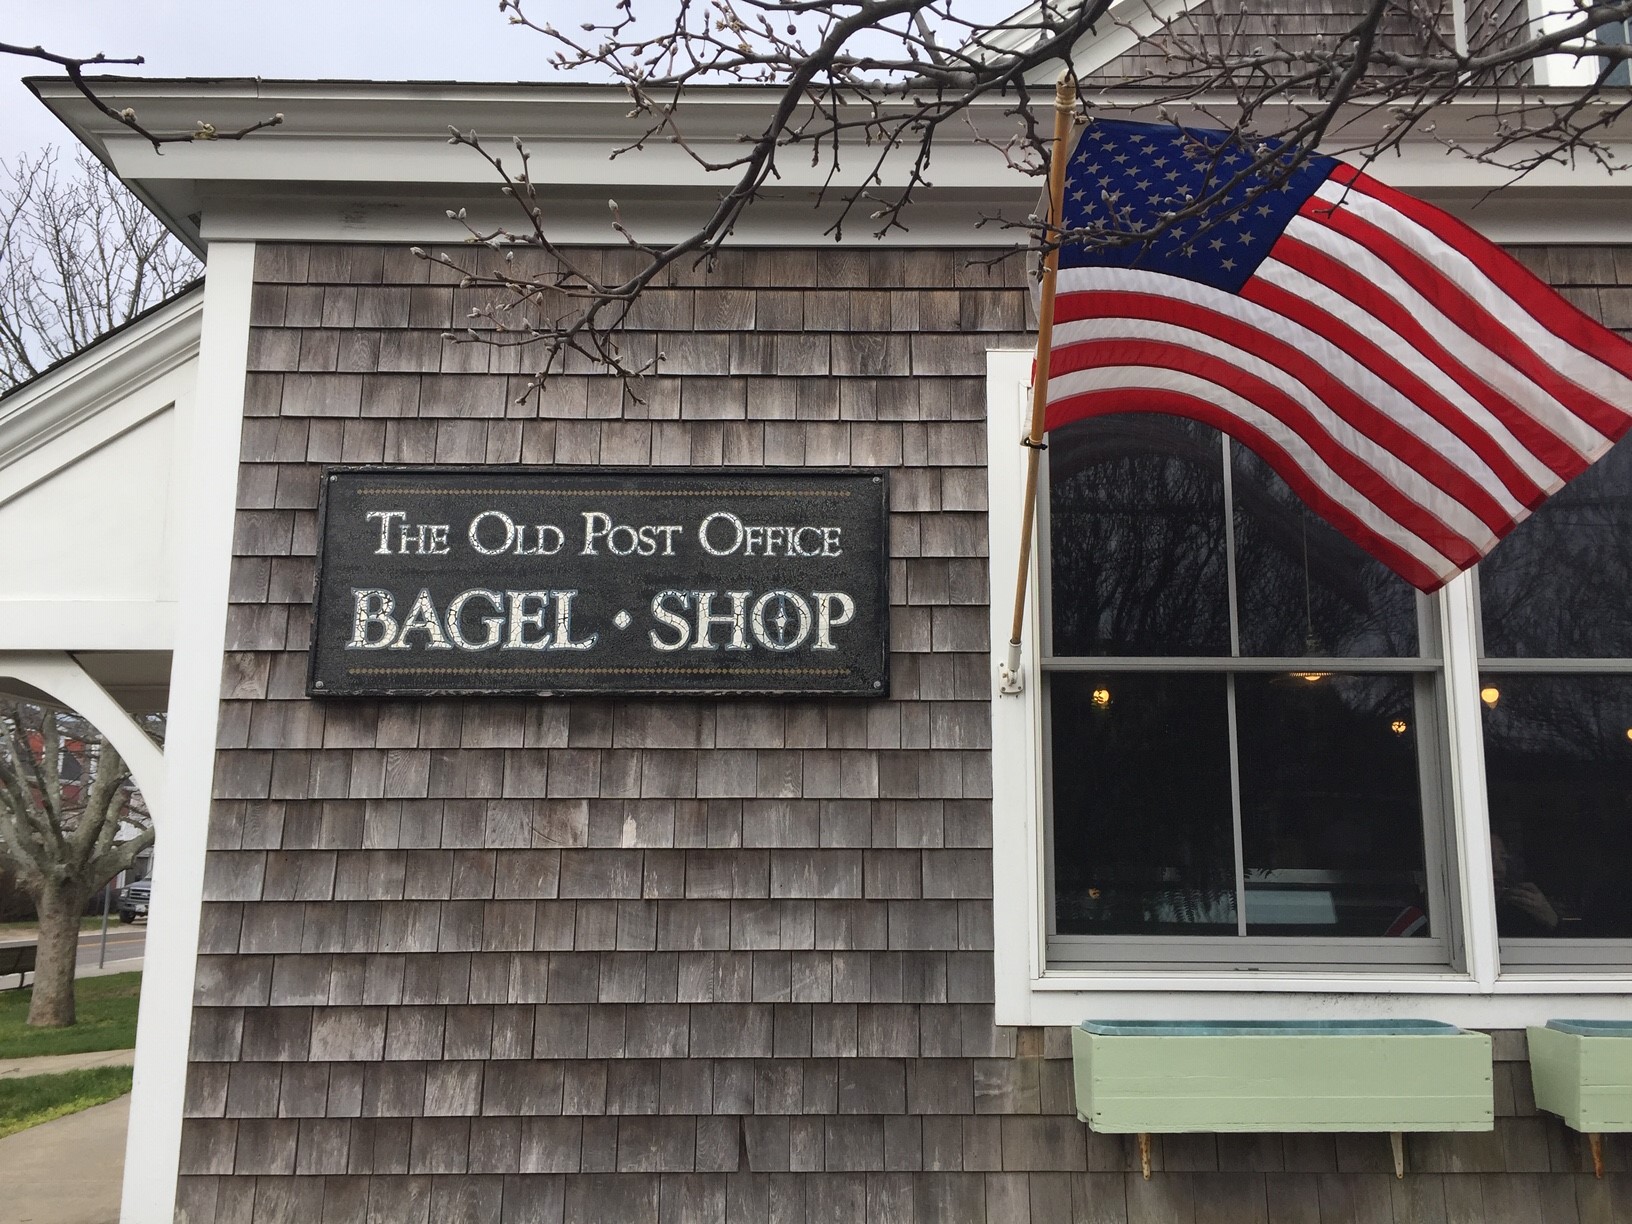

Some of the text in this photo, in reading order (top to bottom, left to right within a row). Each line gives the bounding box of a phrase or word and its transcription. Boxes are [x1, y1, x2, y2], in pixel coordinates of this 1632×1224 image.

[365, 510, 842, 557] THE OLD POST OFFICE
[345, 588, 855, 652] BAGEL SHOP
